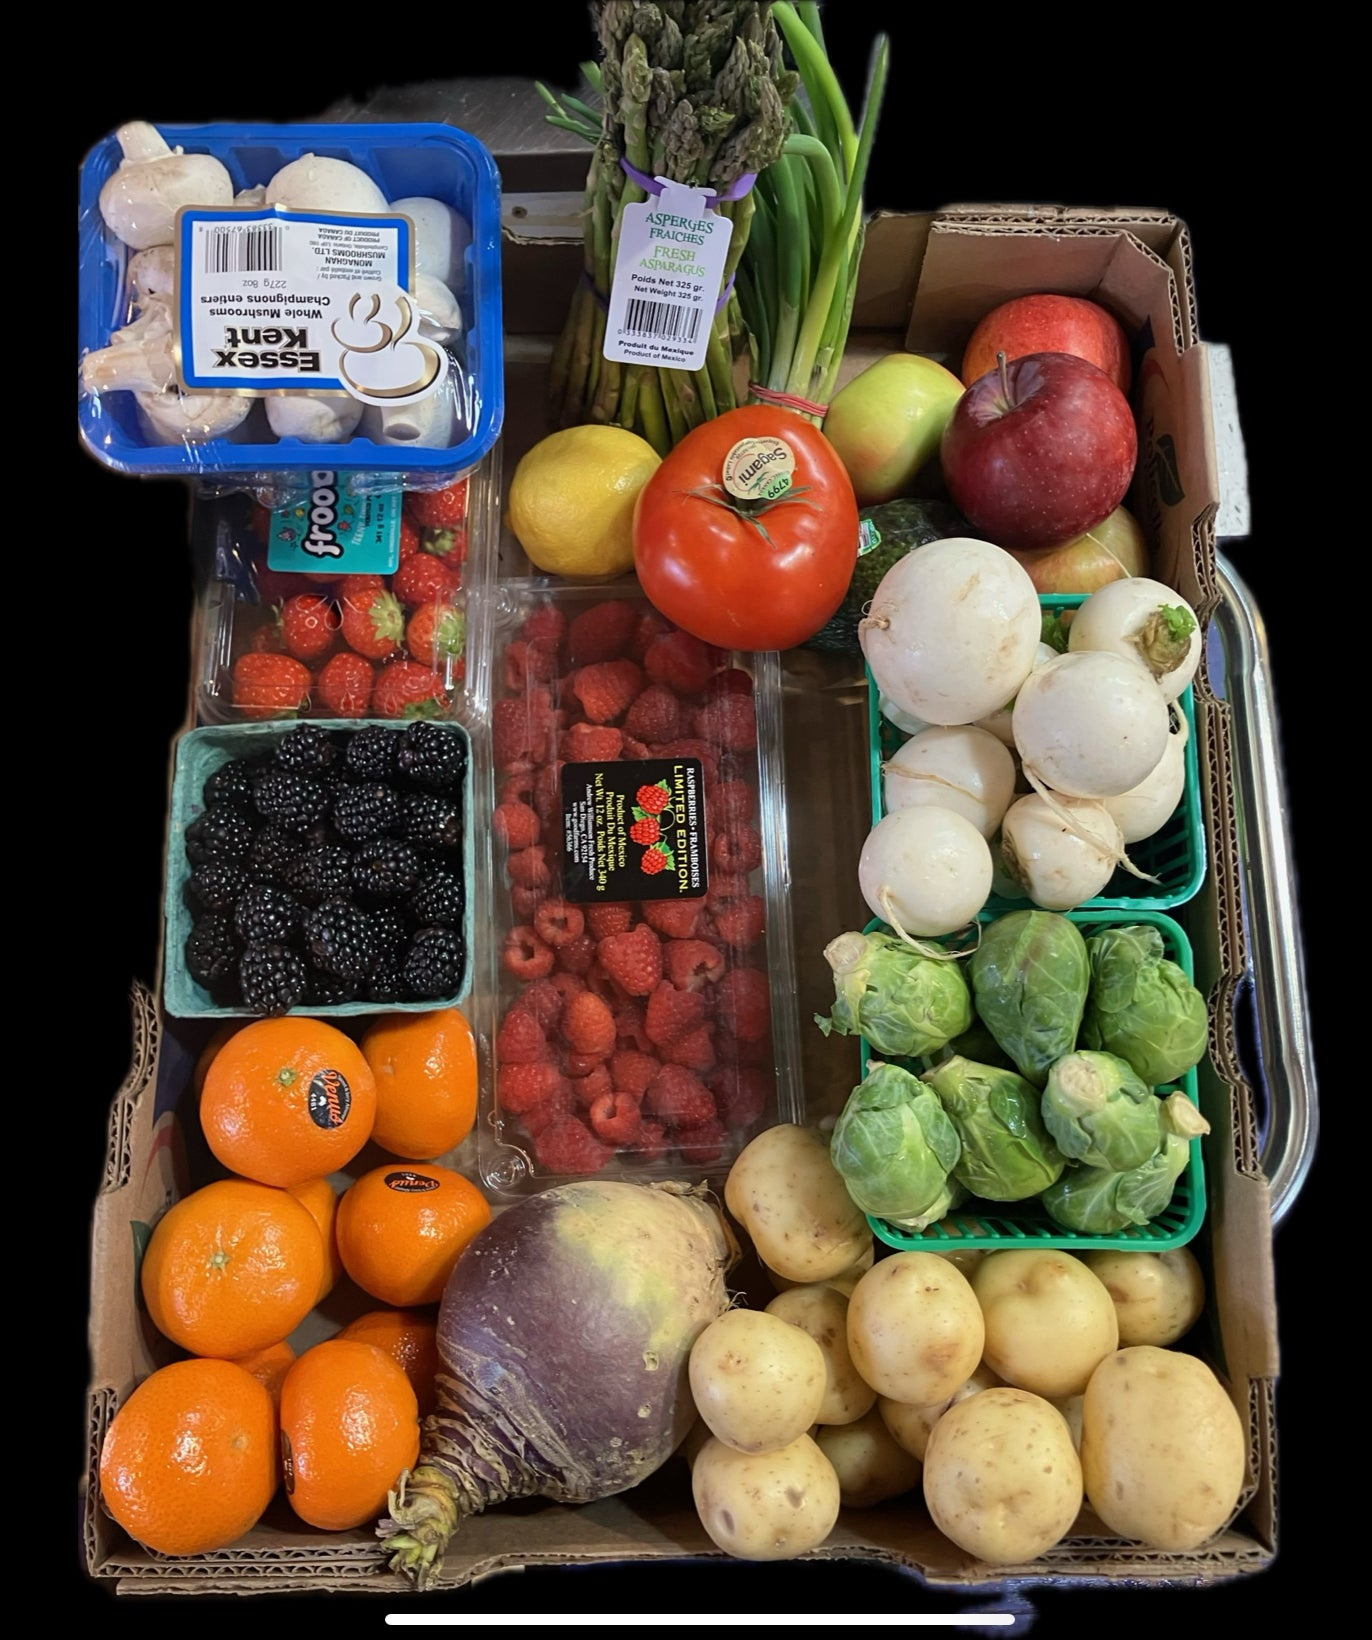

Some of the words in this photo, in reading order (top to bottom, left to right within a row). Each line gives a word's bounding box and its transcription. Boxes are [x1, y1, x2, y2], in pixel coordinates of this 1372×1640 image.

[645, 212, 714, 233] ASPERGES
[649, 228, 705, 245] FRAICHES
[312, 247, 329, 256] LTD.
[332, 249, 386, 258] MUSHROOMS
[654, 246, 696, 261] FRESH
[325, 256, 372, 267] MONAGHAN
[640, 258, 705, 277] ASPARAGUS
[243, 280, 258, 288] 8oz
[264, 278, 287, 288] 227g
[632, 274, 656, 285] Poids
[659, 278, 674, 286] Net
[676, 281, 692, 290] 325
[693, 284, 705, 292] gr.
[201, 295, 243, 305] entiers
[247, 294, 331, 306] Champignons
[634, 285, 648, 293] Net
[649, 287, 676, 298] Weight
[693, 294, 703, 302] gr.
[209, 308, 280, 318] Mushrooms
[285, 309, 322, 319] Whole
[224, 326, 309, 349] Kent
[618, 340, 647, 350] Produit
[662, 345, 694, 355] Mexique
[212, 350, 321, 372] Essex
[624, 349, 651, 358] Product
[662, 353, 686, 362] Mexico
[739, 447, 787, 486] Sagami
[768, 478, 789, 498] 4799
[595, 773, 603, 787] Net
[596, 788, 604, 802] Wt.
[674, 765, 685, 823] LIMITED
[686, 768, 697, 826] RASPBERRIES
[596, 805, 604, 814] 12
[606, 792, 615, 820] Produit
[616, 794, 625, 825] Product
[578, 814, 586, 833] Diego,
[607, 822, 615, 834] Du
[618, 826, 626, 836] of
[572, 802, 580, 863] www.goodfarms.com
[581, 834, 587, 844] CA
[596, 831, 606, 852] Poids
[605, 836, 616, 871] Mexique
[618, 837, 627, 867] Mexico
[598, 854, 606, 868] Net
[690, 832, 699, 888] FRAMBOISES
[598, 870, 606, 884] 340
[321, 1071, 344, 1125] Venus
[389, 1180, 438, 1188] Venus
